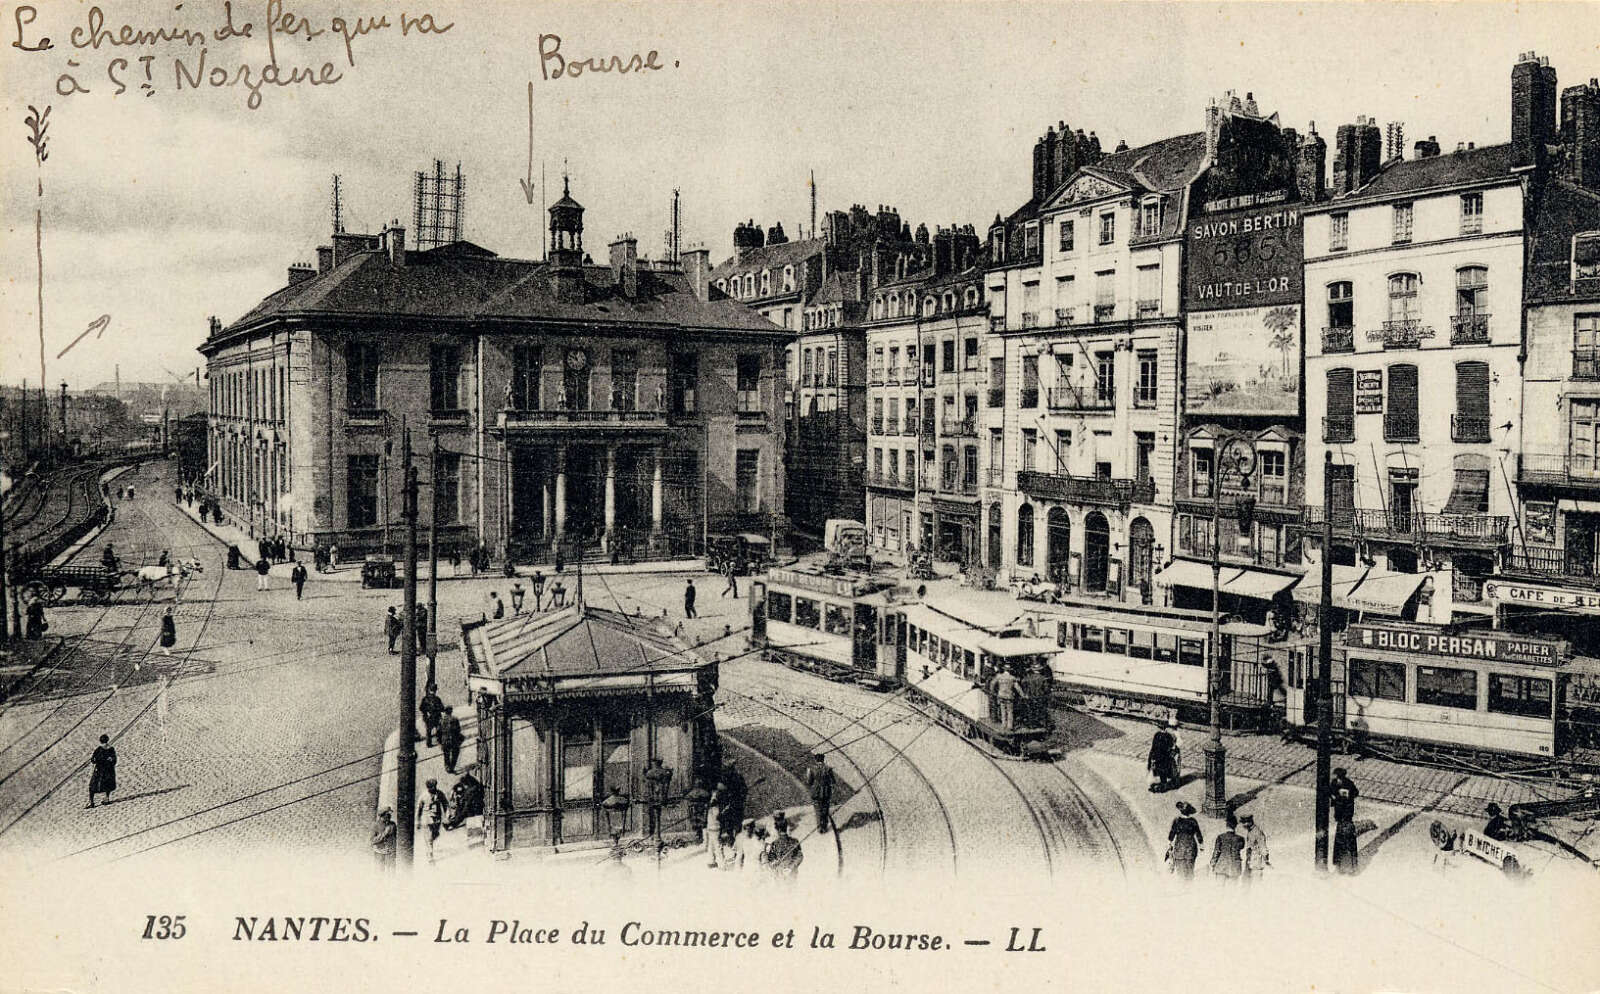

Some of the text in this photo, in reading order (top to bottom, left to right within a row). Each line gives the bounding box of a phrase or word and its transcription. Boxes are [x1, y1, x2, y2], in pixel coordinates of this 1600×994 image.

[12, 5, 54, 51] Le
[71, 4, 205, 49] chemin
[214, 1, 253, 41] de
[1194, 210, 1298, 240] SAVON BERTIN
[1198, 282, 1233, 299] VAUT
[1235, 282, 1251, 296] DE
[1510, 588, 1544, 601] CAFE
[1553, 596, 1566, 604] DE
[1379, 631, 1497, 658] BLOC PERSAN
[1508, 642, 1549, 656] PAPIER
